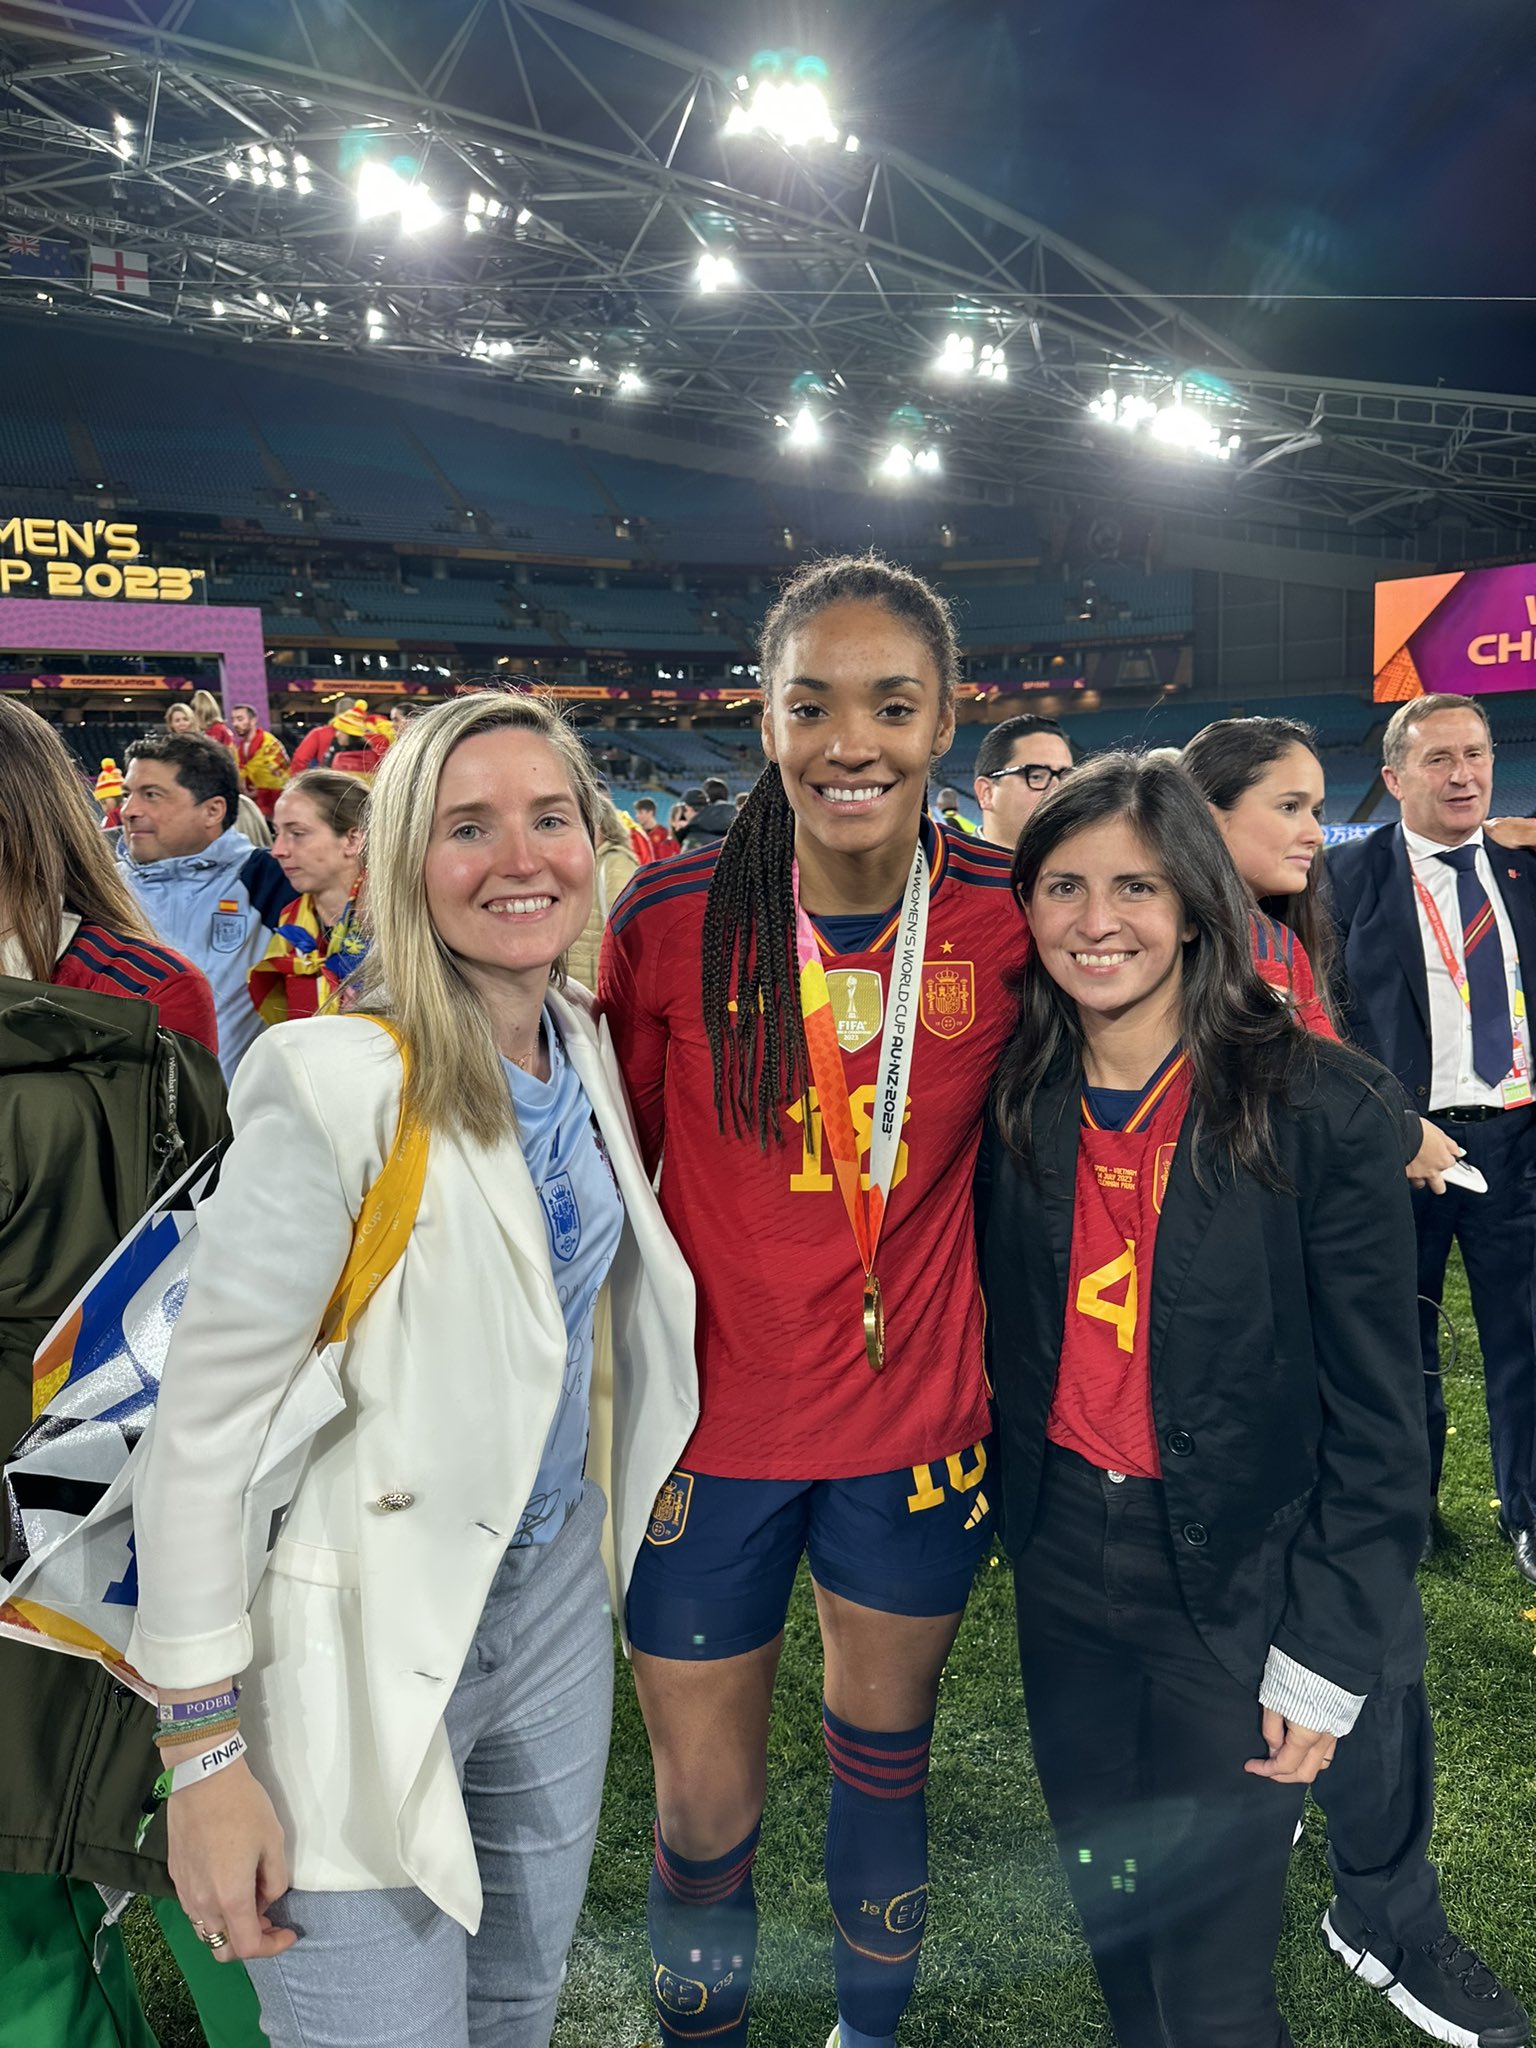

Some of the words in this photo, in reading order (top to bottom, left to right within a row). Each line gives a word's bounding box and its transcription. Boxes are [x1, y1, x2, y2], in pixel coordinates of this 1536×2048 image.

[1467, 630, 1536, 666] CH
[905, 877, 922, 946] WOMEN'S
[898, 949, 915, 1000] WORLD
[838, 1020, 865, 1031] FIFA
[894, 1002, 908, 1035] CUP
[168, 1056, 177, 1093] Wombat
[1076, 1238, 1138, 1354] 4
[186, 1694, 232, 1715] PODER
[201, 1736, 244, 1771] FINAL
